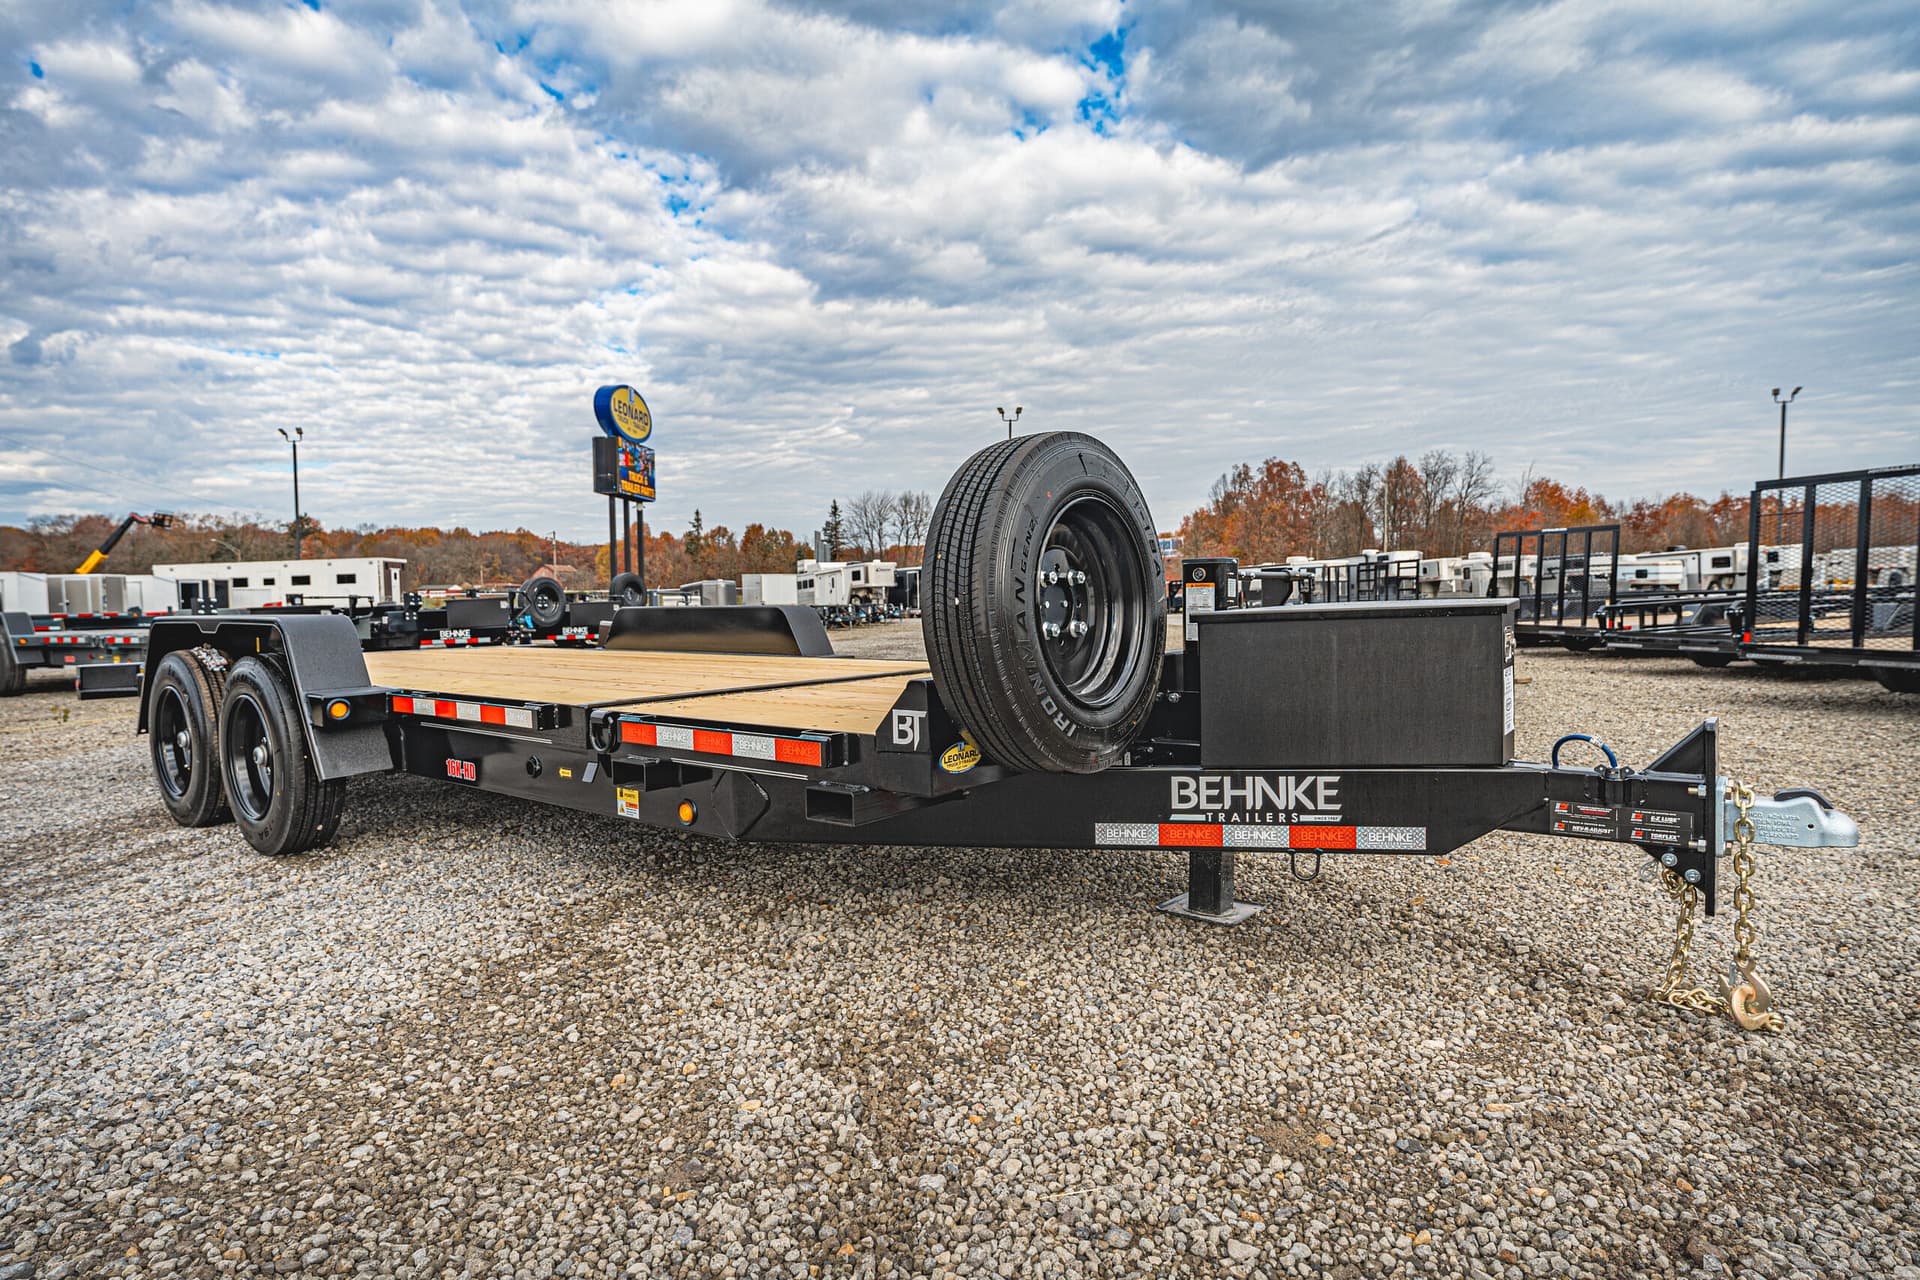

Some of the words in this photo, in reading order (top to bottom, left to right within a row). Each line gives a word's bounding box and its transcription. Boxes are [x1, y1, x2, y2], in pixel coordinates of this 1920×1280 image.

[613, 397, 649, 427] LEONARD
[439, 628, 471, 639] BEHNKE
[562, 626, 589, 635] BEHNKE
[1014, 576, 1077, 738] IRONMAN
[892, 709, 928, 752] BT
[661, 731, 688, 743] BEHNKE
[739, 740, 768, 752] BEHNKE
[782, 745, 814, 757] BEHNKE
[445, 758, 476, 782] 16K-HD
[1170, 776, 1342, 810] BEHNKE
[1206, 812, 1299, 823] TRAILERS
[1106, 829, 1147, 838] BEHNKE
[1169, 829, 1211, 839] BEHNKE
[1234, 830, 1277, 840] BEHNKE
[1301, 831, 1345, 841] BEHNKE
[1368, 832, 1413, 842] BEHNKE
